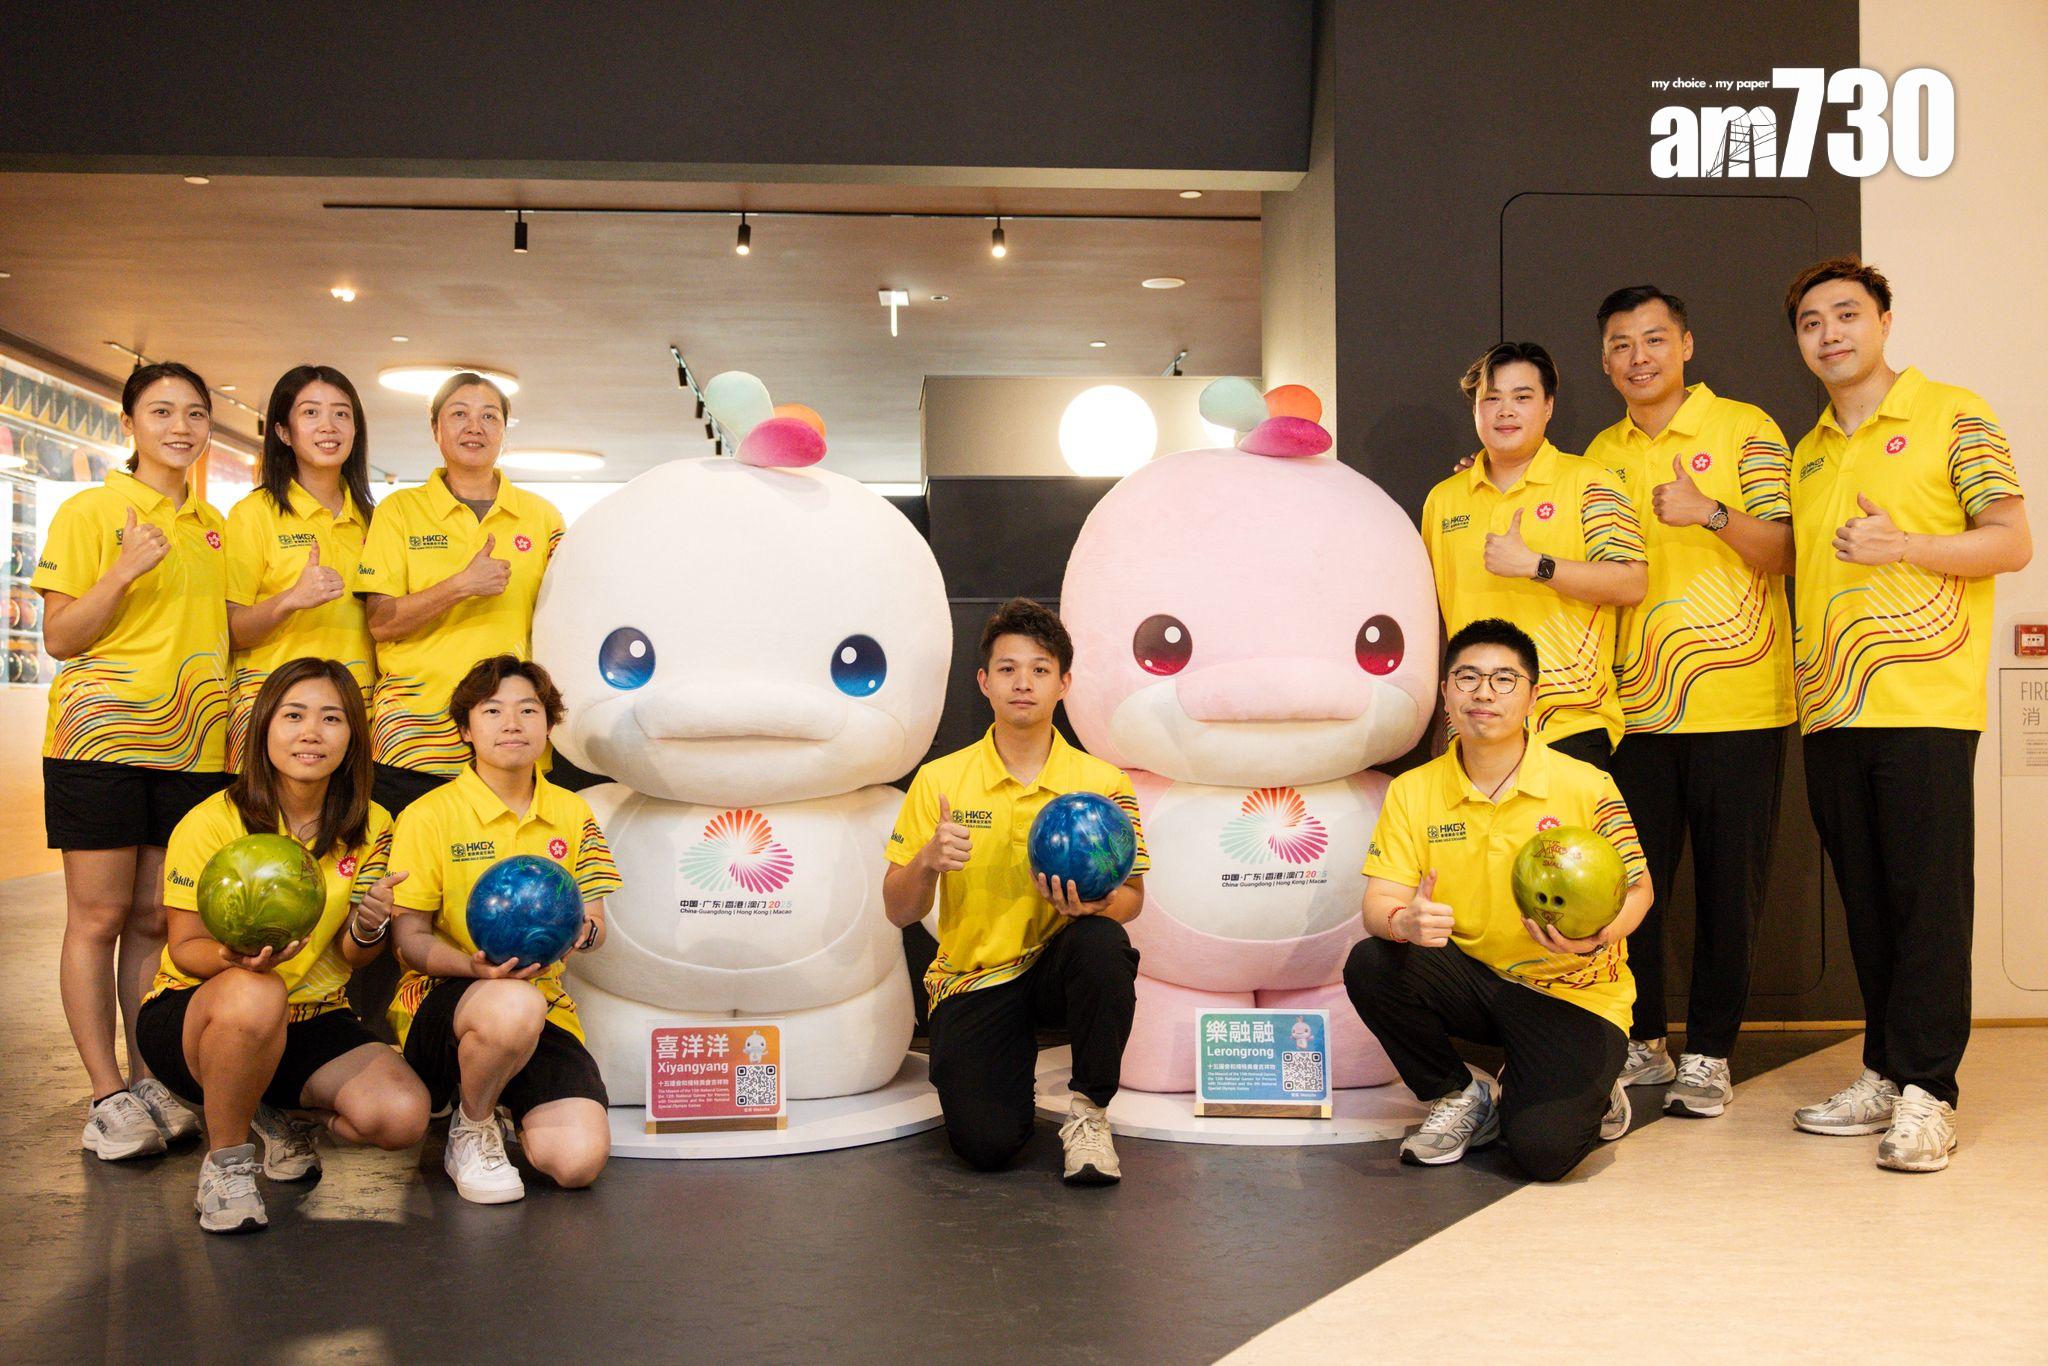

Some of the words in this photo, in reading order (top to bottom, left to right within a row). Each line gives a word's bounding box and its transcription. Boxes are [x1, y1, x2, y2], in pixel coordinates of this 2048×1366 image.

[965, 810, 992, 820] HKGX
[466, 841, 495, 851] HKGX
[1206, 1020, 1275, 1043] 樂融融
[655, 1034, 730, 1059] 喜洋洋
[1207, 1046, 1274, 1059] Lerongrong
[657, 1061, 729, 1075] Xiyangyang
